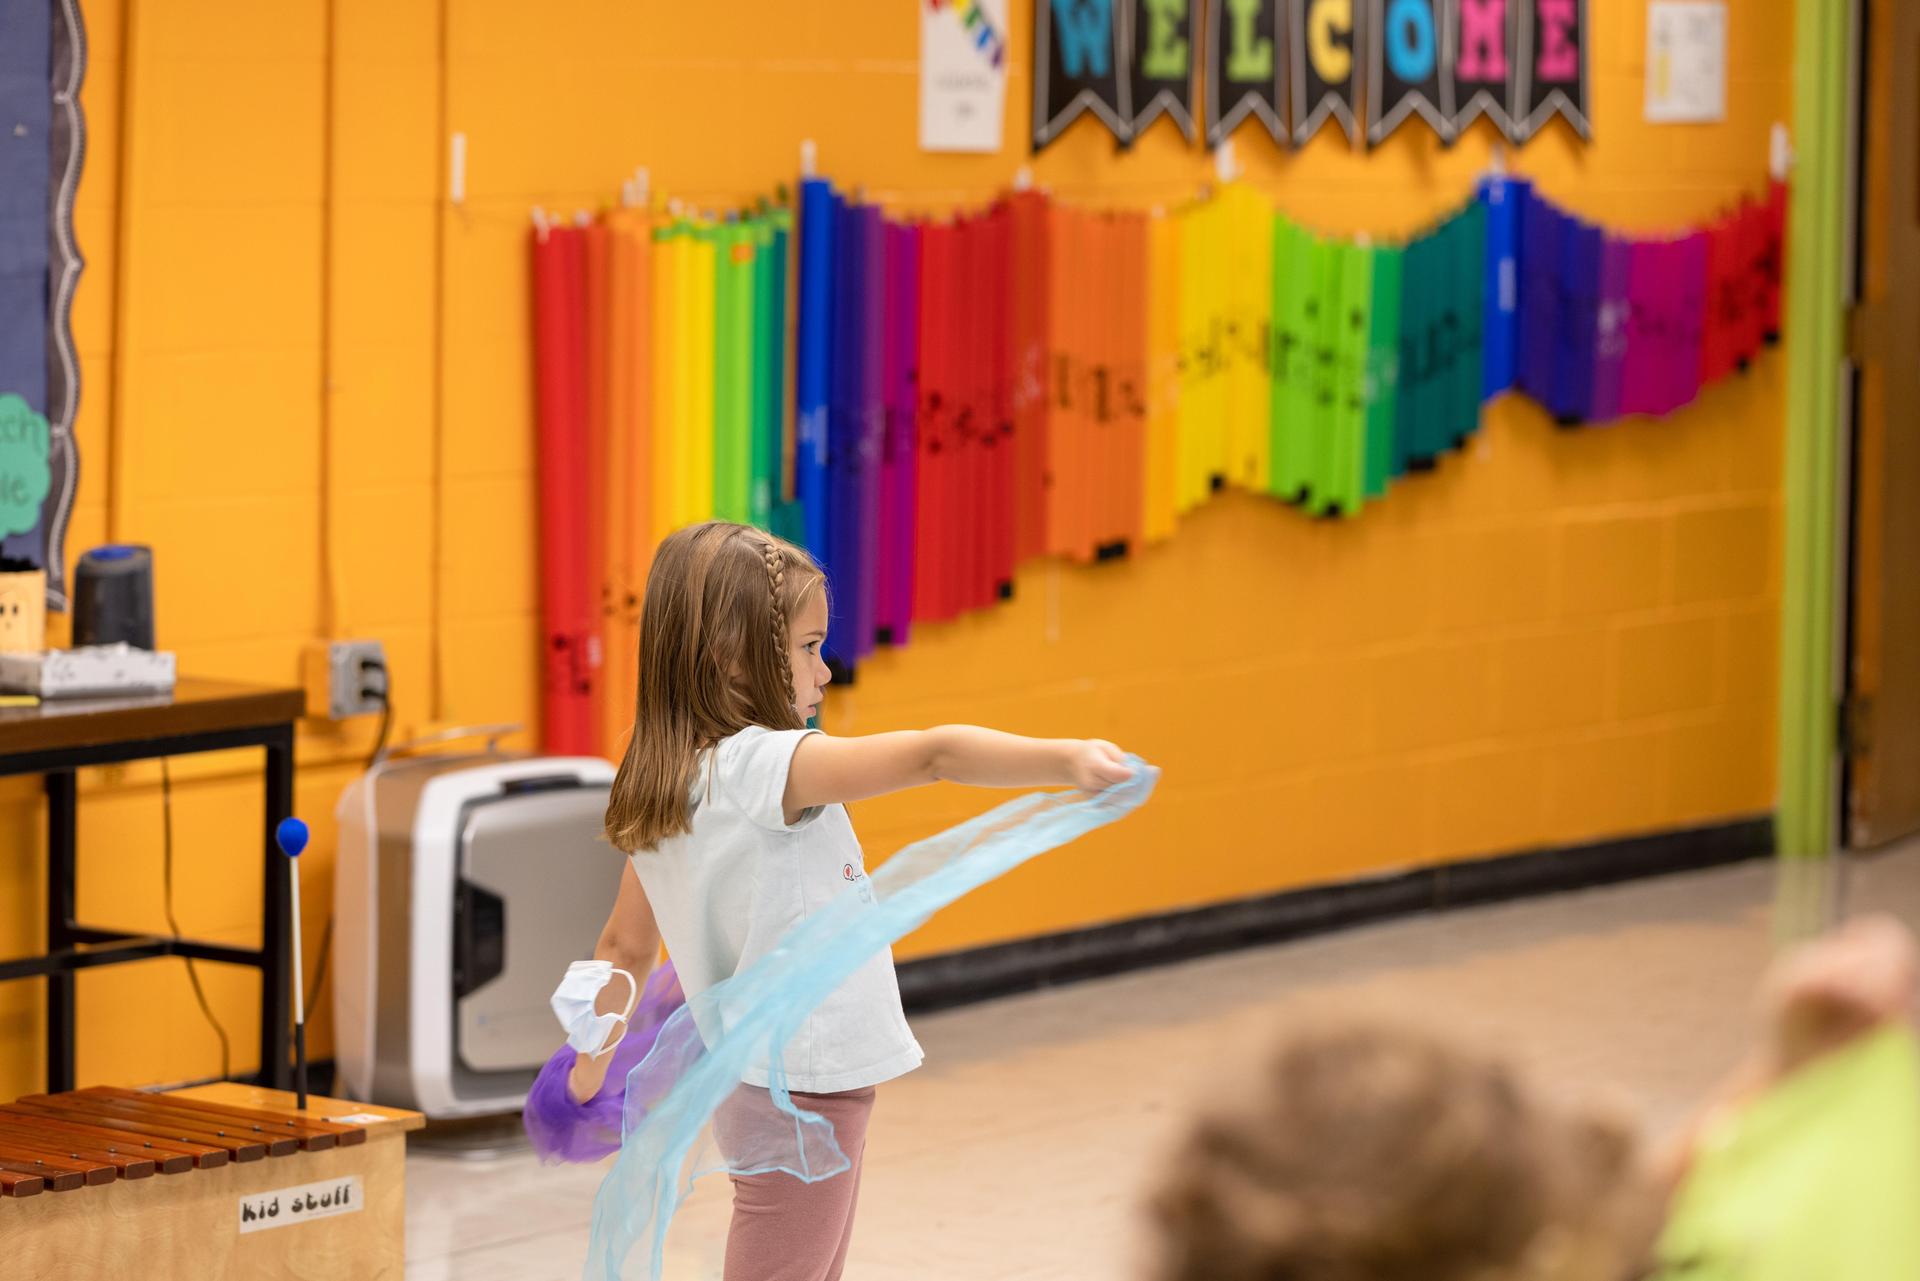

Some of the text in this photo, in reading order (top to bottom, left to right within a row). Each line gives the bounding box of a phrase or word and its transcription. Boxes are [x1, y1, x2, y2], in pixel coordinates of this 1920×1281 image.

[1052, 0, 1579, 83] WELCOME
[242, 1184, 350, 1222] kid stuff
